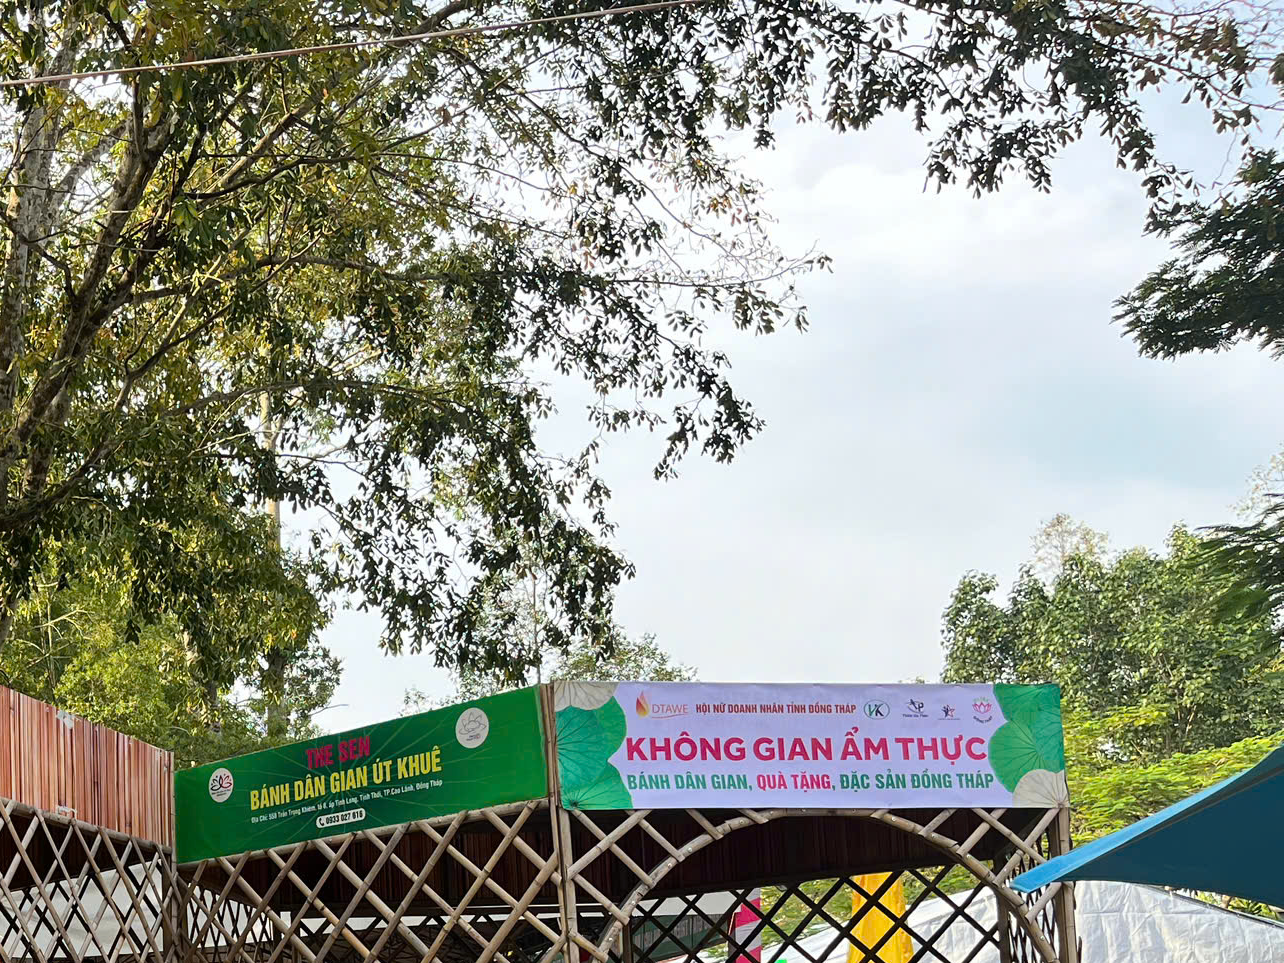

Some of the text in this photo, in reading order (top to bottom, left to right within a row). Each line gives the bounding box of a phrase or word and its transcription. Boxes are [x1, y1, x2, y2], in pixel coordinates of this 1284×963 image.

[651, 704, 688, 714] DTAWE
[696, 701, 856, 715] HỘI NỮ DOANH NHÂN TỈNH ĐỒNG THÁP
[306, 736, 370, 769] THE SEN
[626, 726, 987, 765] KHÔNG GIAN ẨM THỰC
[250, 745, 443, 811] BÁNH DÂN GIAN ÚT KHUÊ
[627, 768, 994, 792] BÁNH DÂN GIAN, QUÀ TẶNG, ĐẶC SẢN ĐỒNG THÁP
